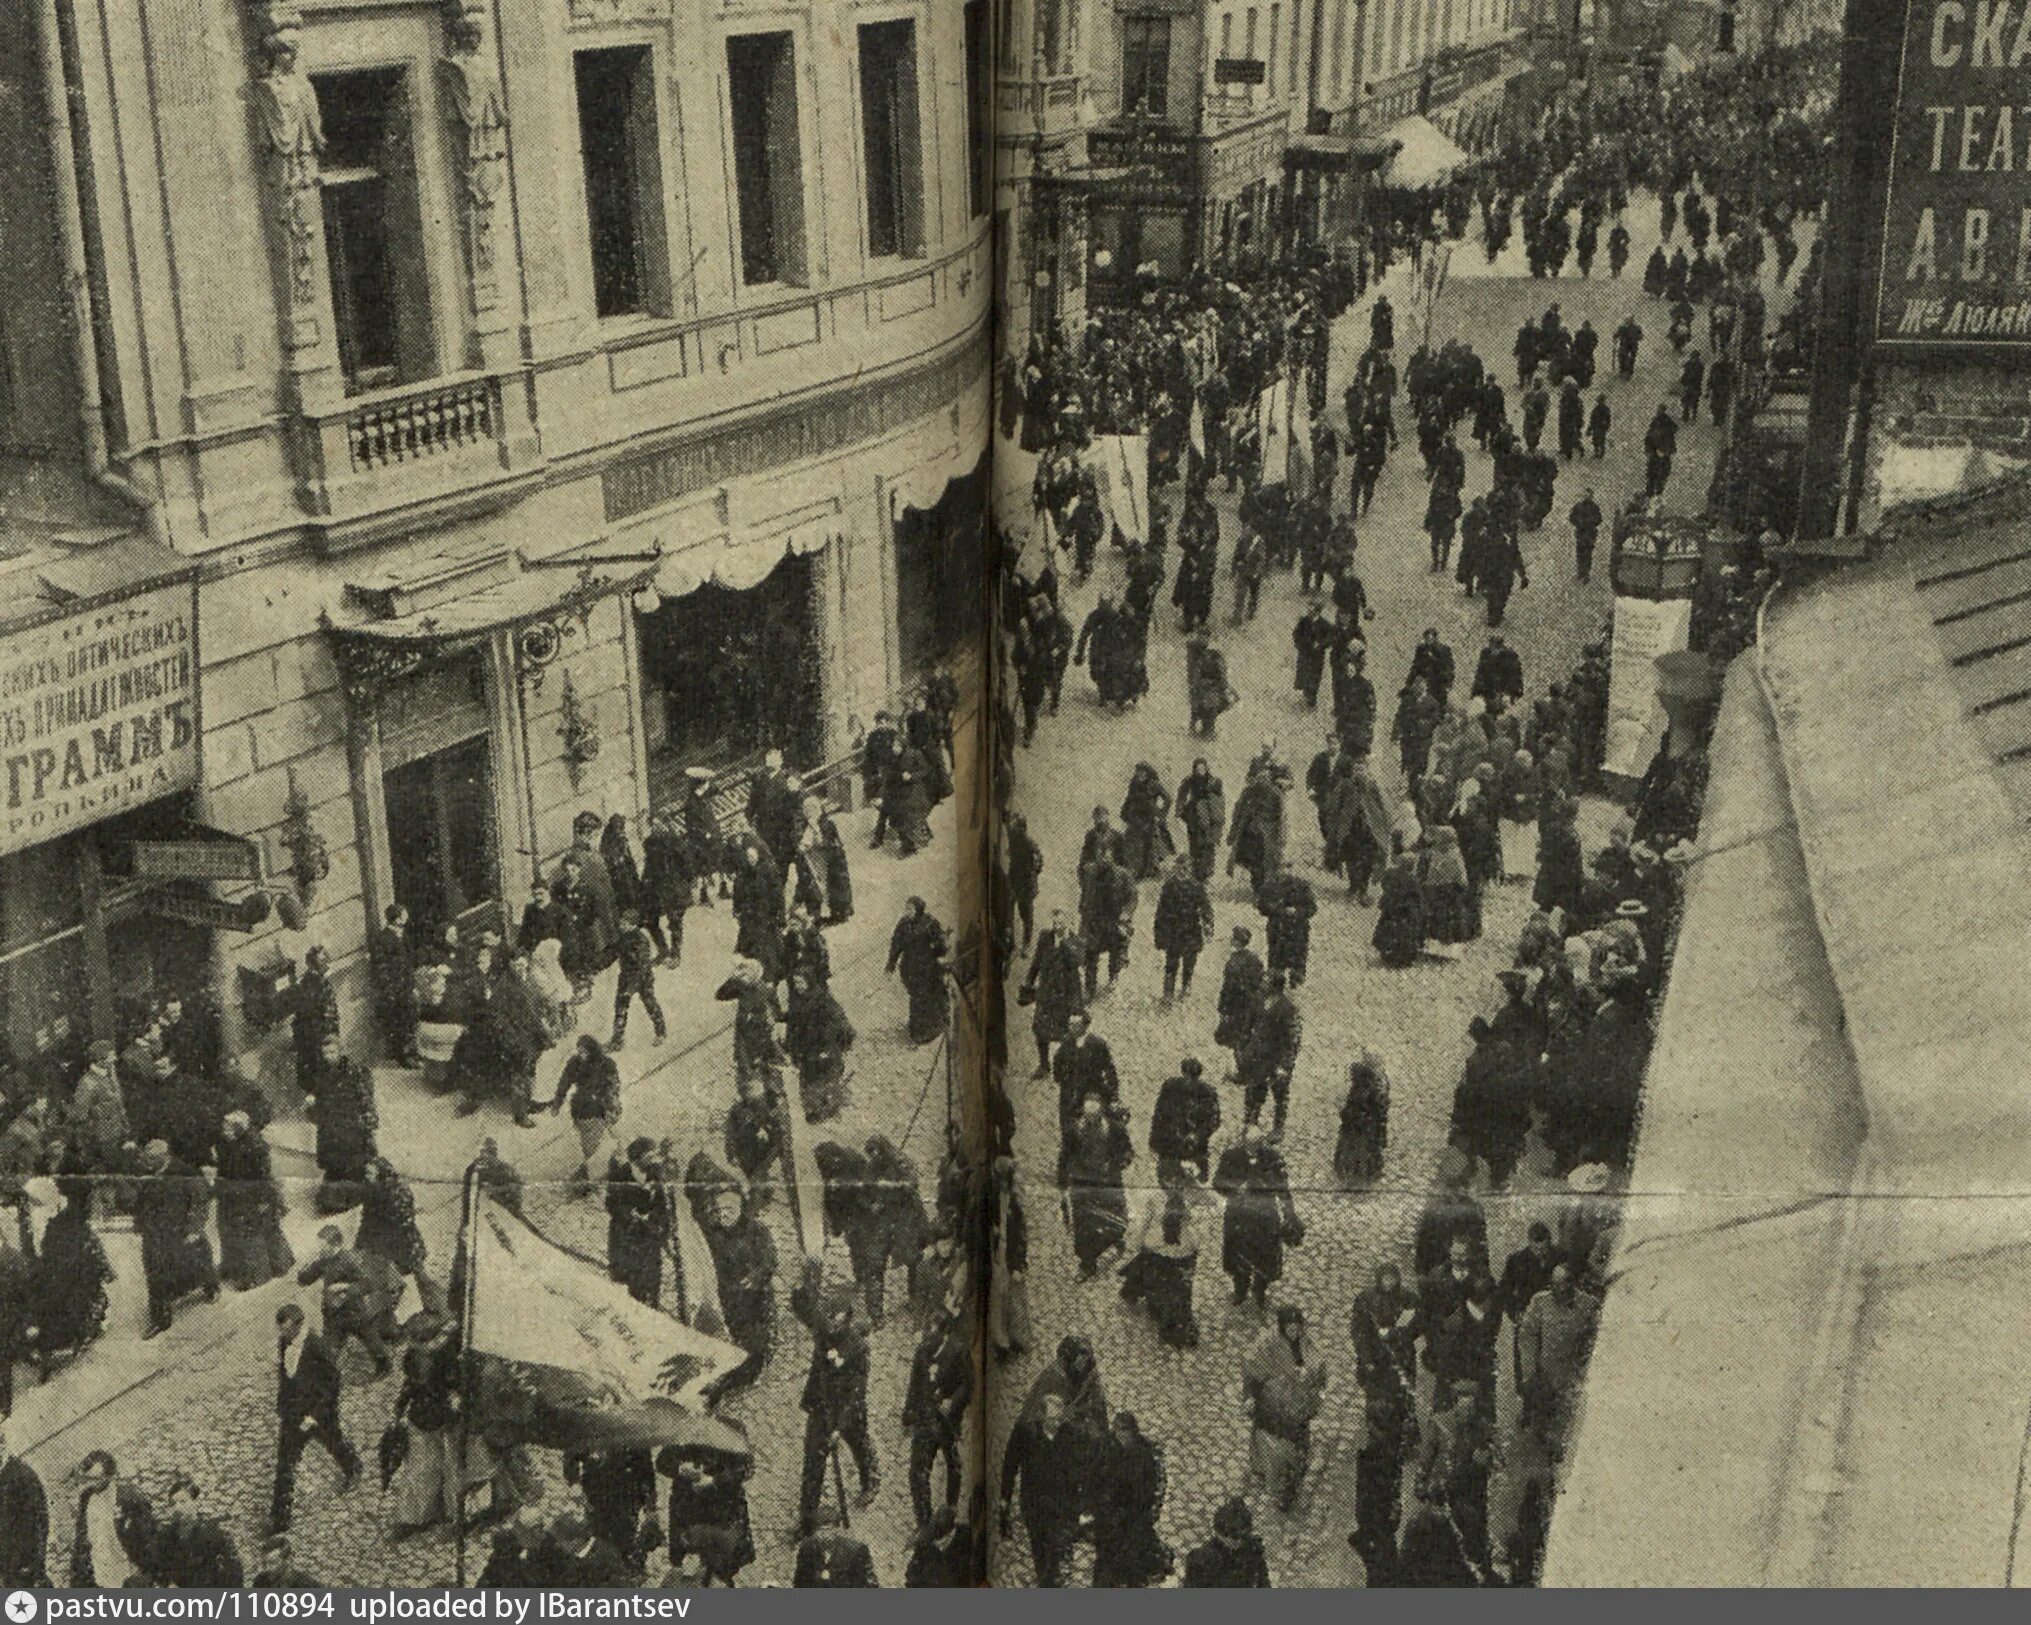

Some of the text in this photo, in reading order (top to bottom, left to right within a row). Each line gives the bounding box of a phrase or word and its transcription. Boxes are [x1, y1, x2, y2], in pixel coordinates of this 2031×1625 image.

[33, 647, 190, 738] ПРИНАДЛЕЖНОСТЕЙ
[67, 617, 188, 679] ОПТИЧЕСКИХЪ
[6, 697, 193, 809] ГРАММЪ
